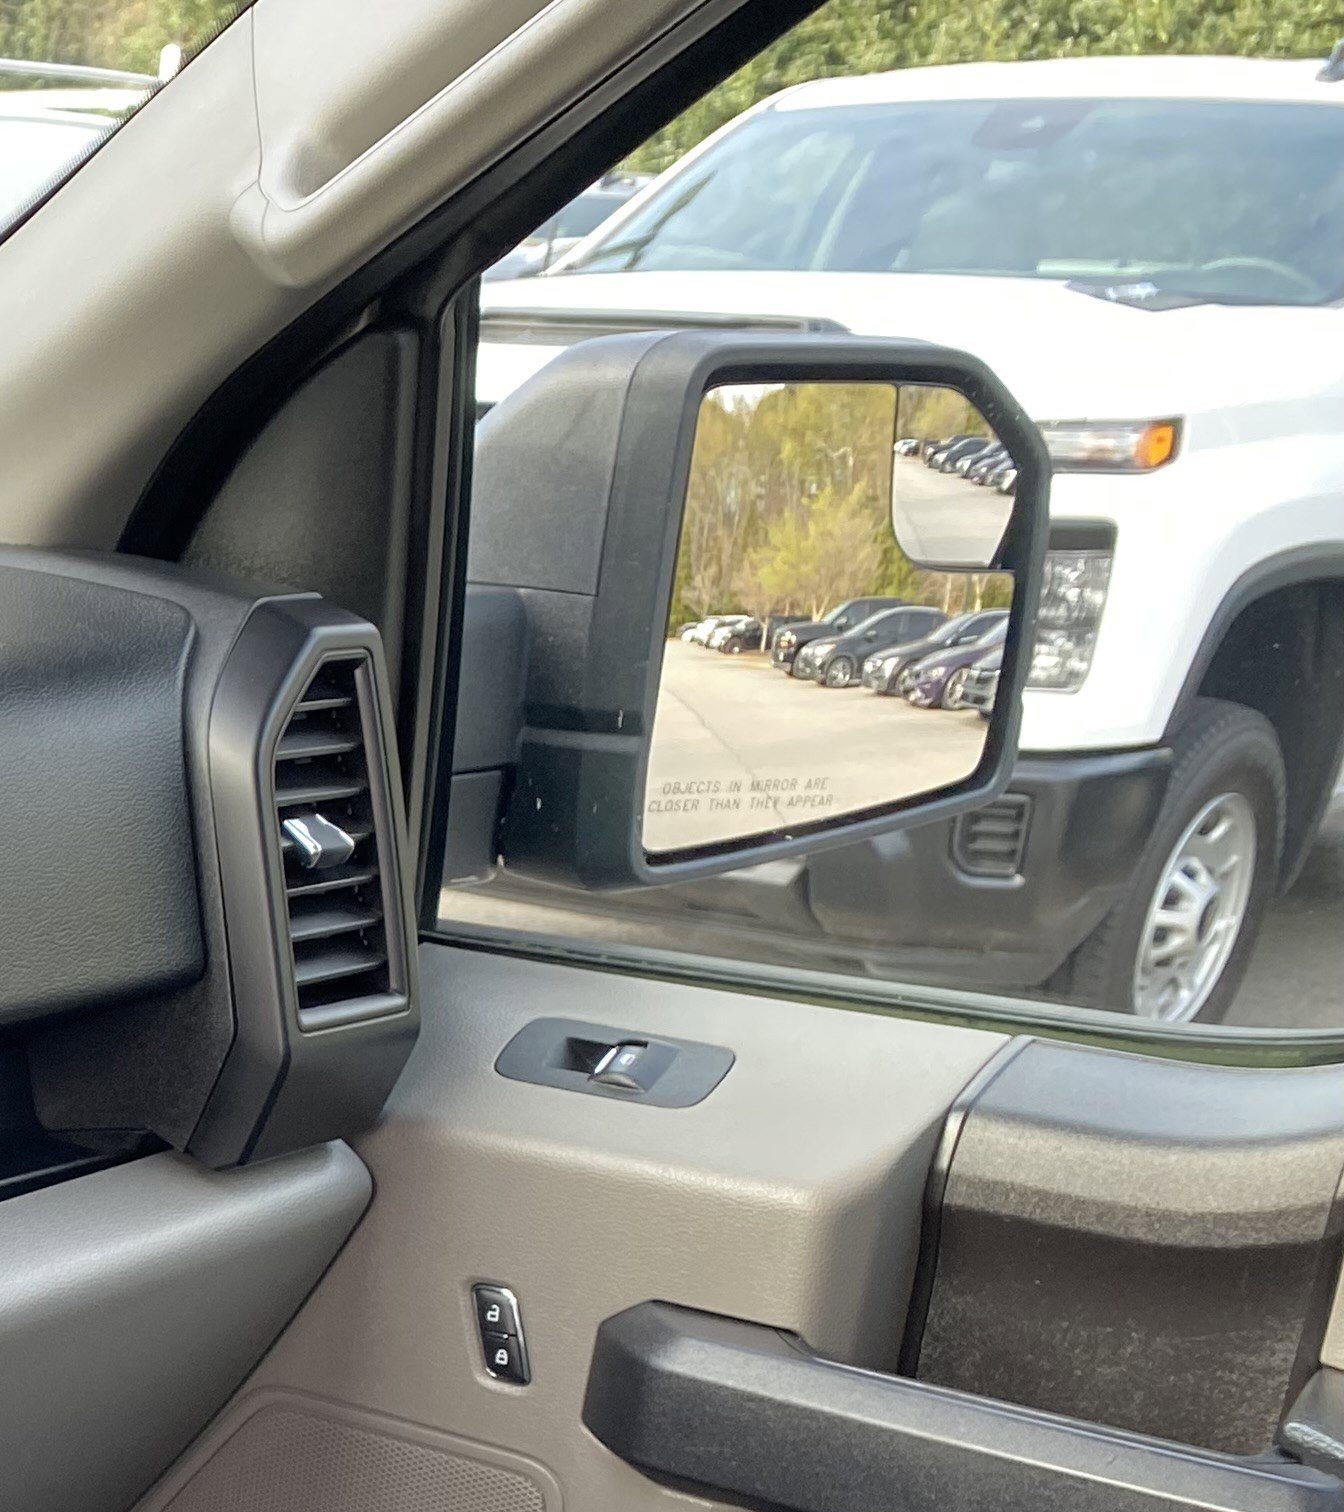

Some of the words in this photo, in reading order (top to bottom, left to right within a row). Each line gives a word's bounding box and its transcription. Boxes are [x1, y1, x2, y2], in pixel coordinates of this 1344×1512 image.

[662, 780, 721, 795] OBJECTS
[728, 780, 742, 793] IN
[804, 777, 830, 791] ARE
[647, 799, 700, 813] CLOSER
[708, 797, 740, 812] THAN
[749, 796, 778, 810] THEY
[787, 794, 834, 808] APPEAR
